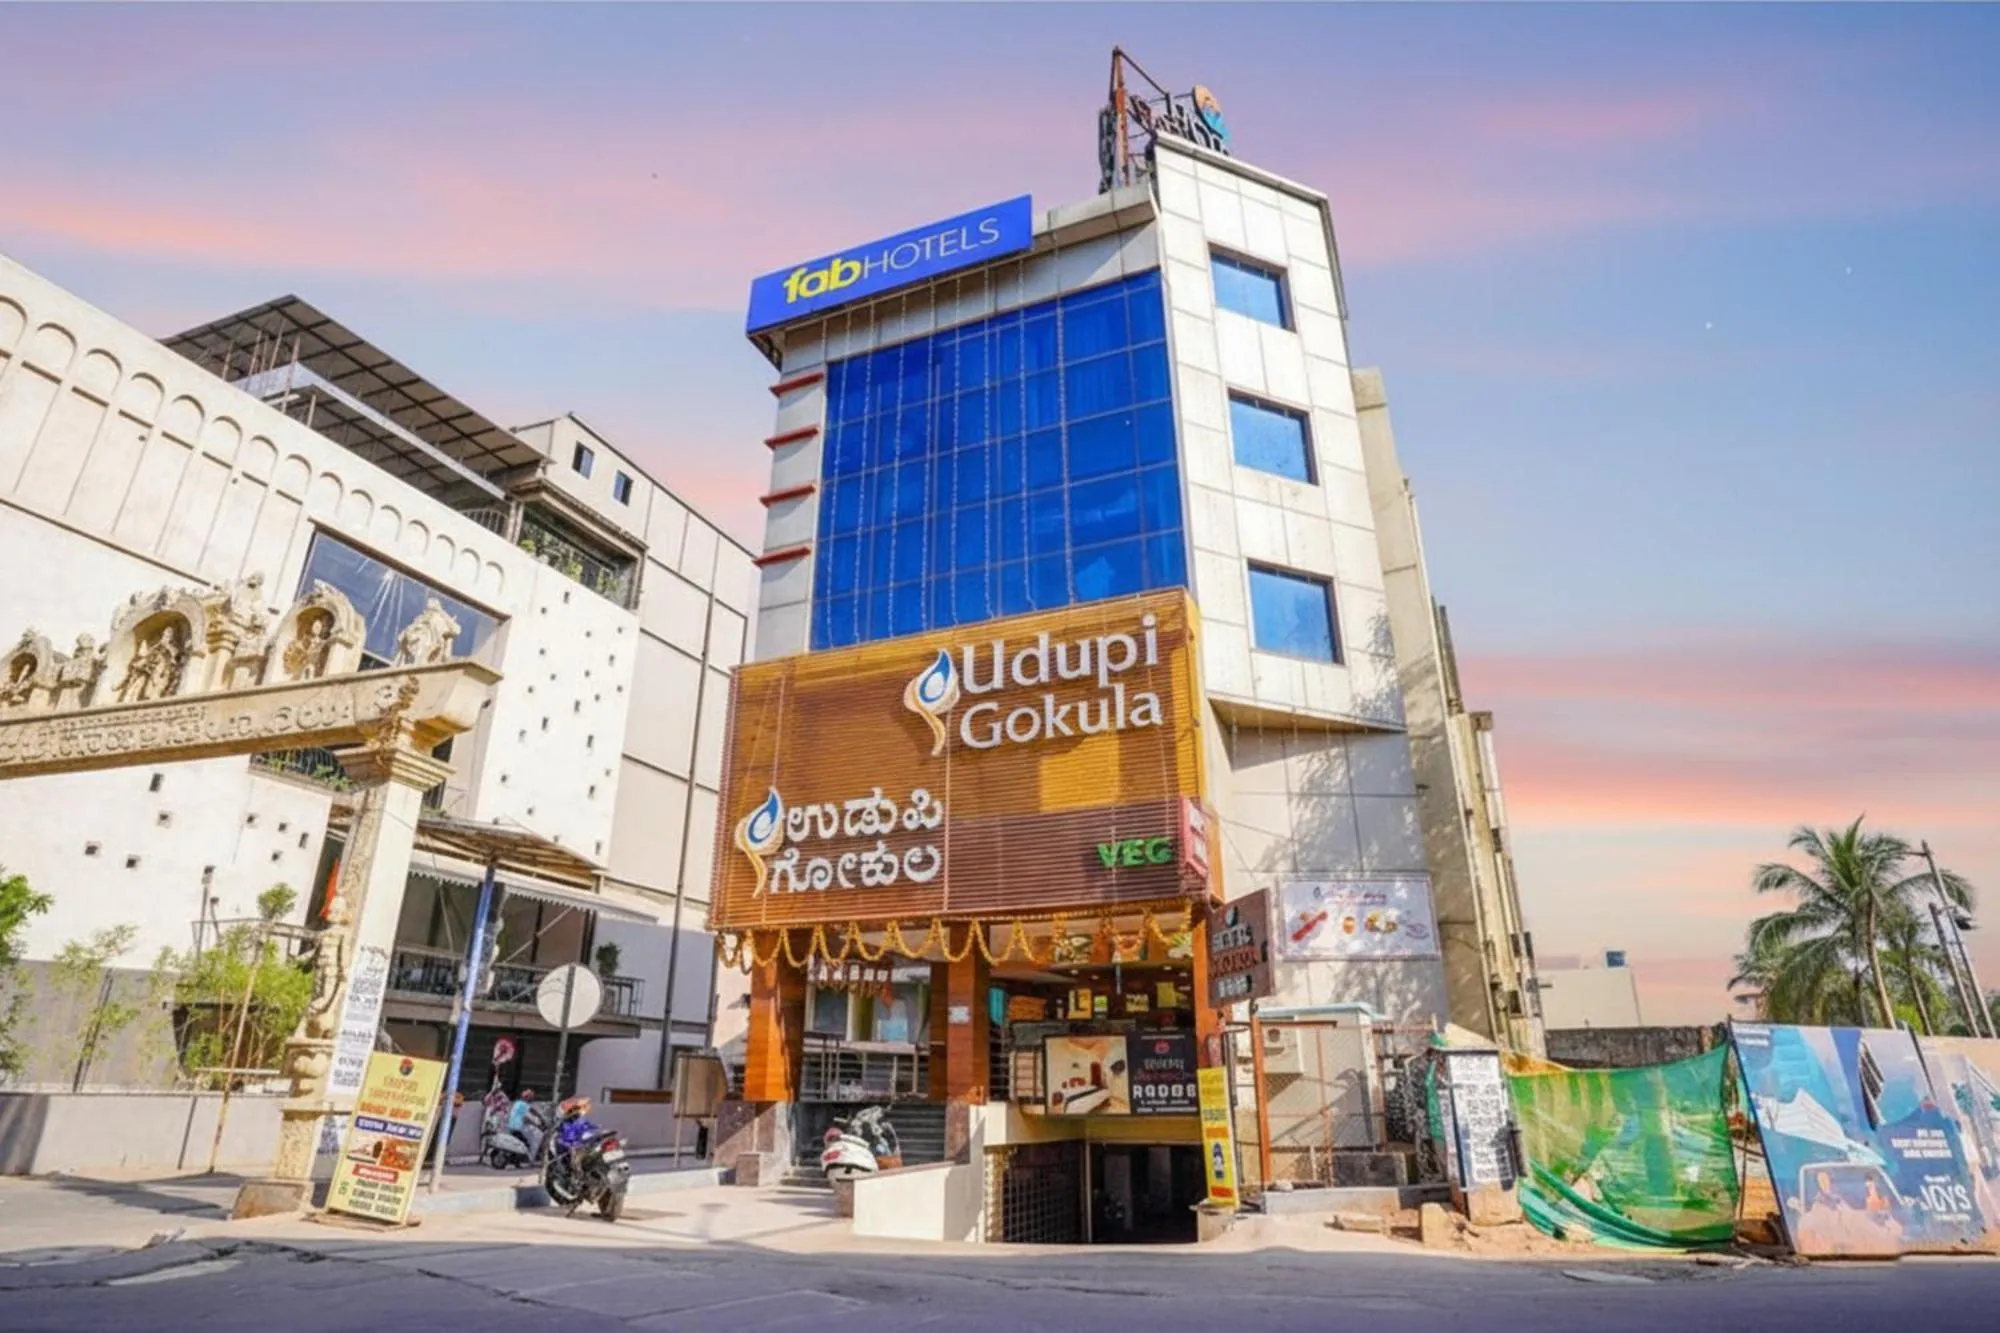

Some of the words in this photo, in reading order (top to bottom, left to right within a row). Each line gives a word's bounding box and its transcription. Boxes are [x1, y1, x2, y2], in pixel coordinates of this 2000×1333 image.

[963, 613, 1158, 694] Udupi
[960, 683, 1163, 749] Gokula
[787, 786, 944, 842] ಉಡುಪಿ
[769, 840, 941, 894] ಗೋಕುಲ
[1096, 836, 1173, 868] VEG
[1919, 1184, 1972, 1213] JOYS
